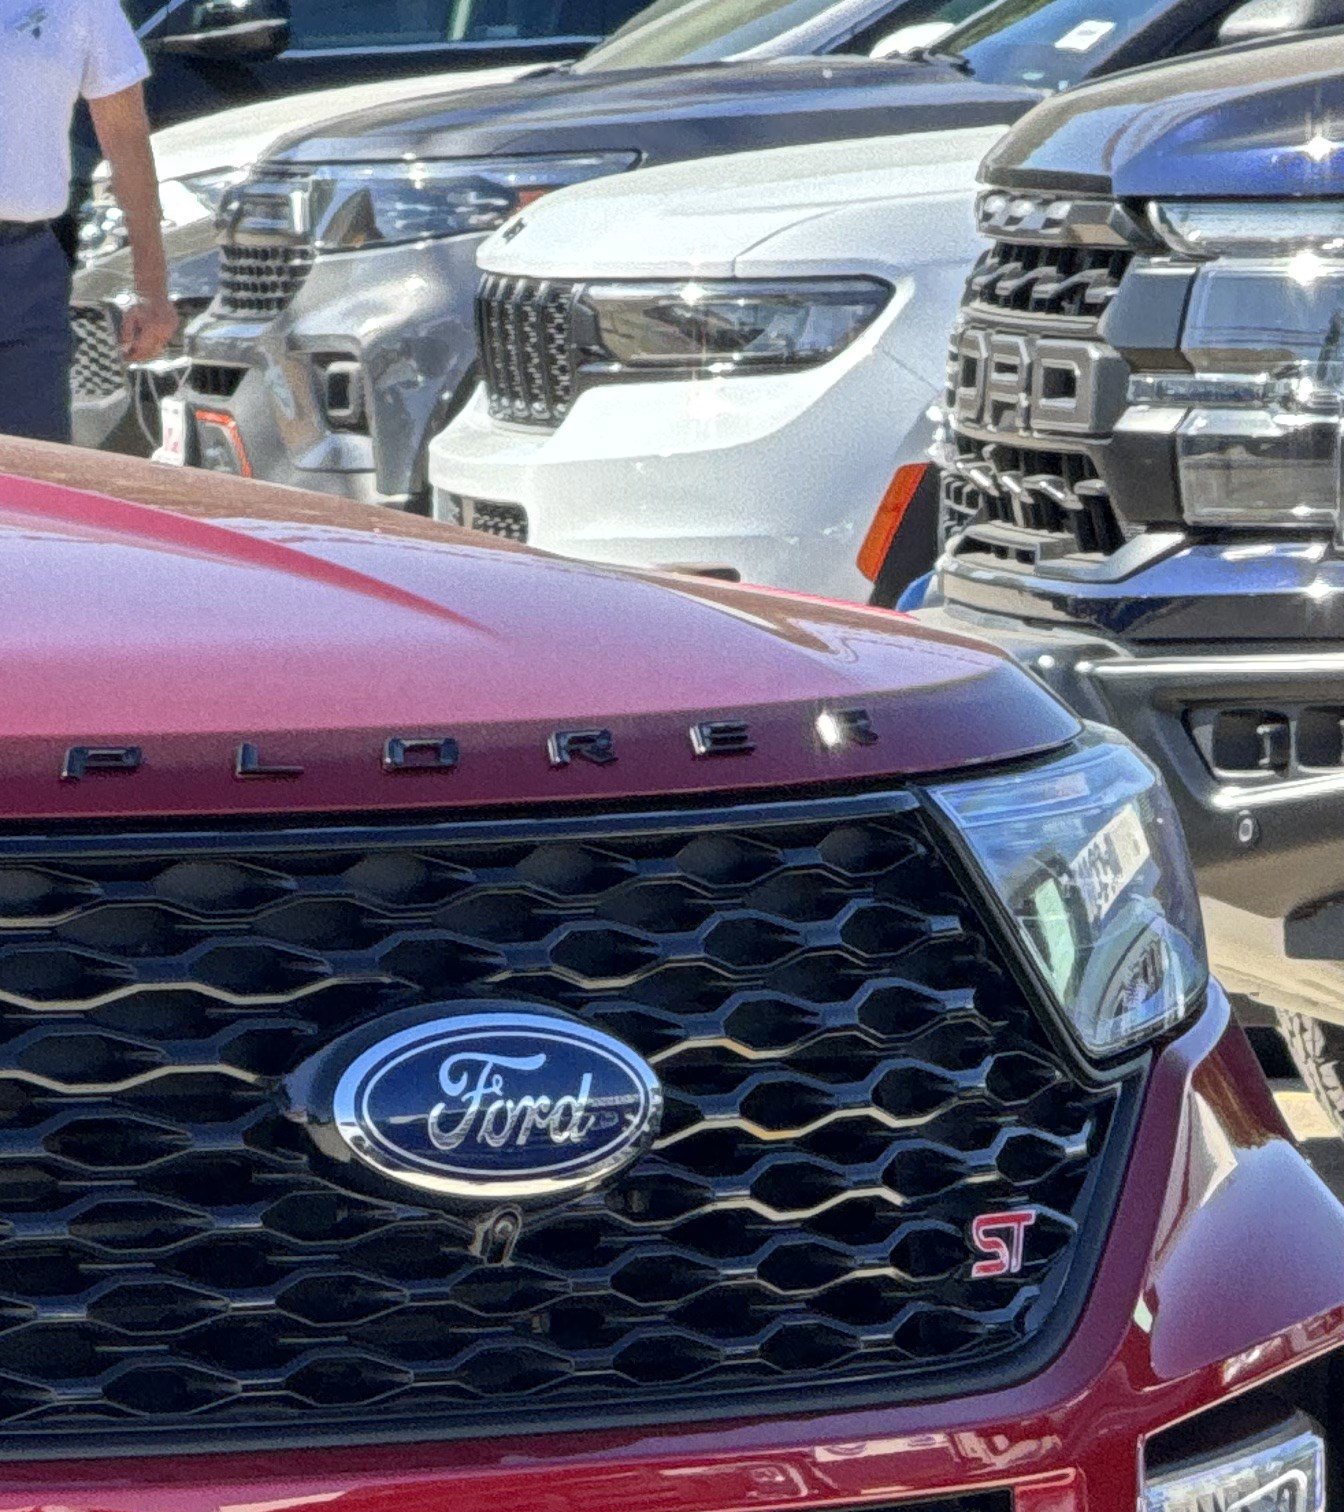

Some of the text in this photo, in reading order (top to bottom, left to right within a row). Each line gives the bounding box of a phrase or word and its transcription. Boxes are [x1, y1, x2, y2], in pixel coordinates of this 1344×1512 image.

[957, 330, 1104, 432] ORD
[428, 1053, 593, 1149] Ford
[971, 1212, 1036, 1278] ST
